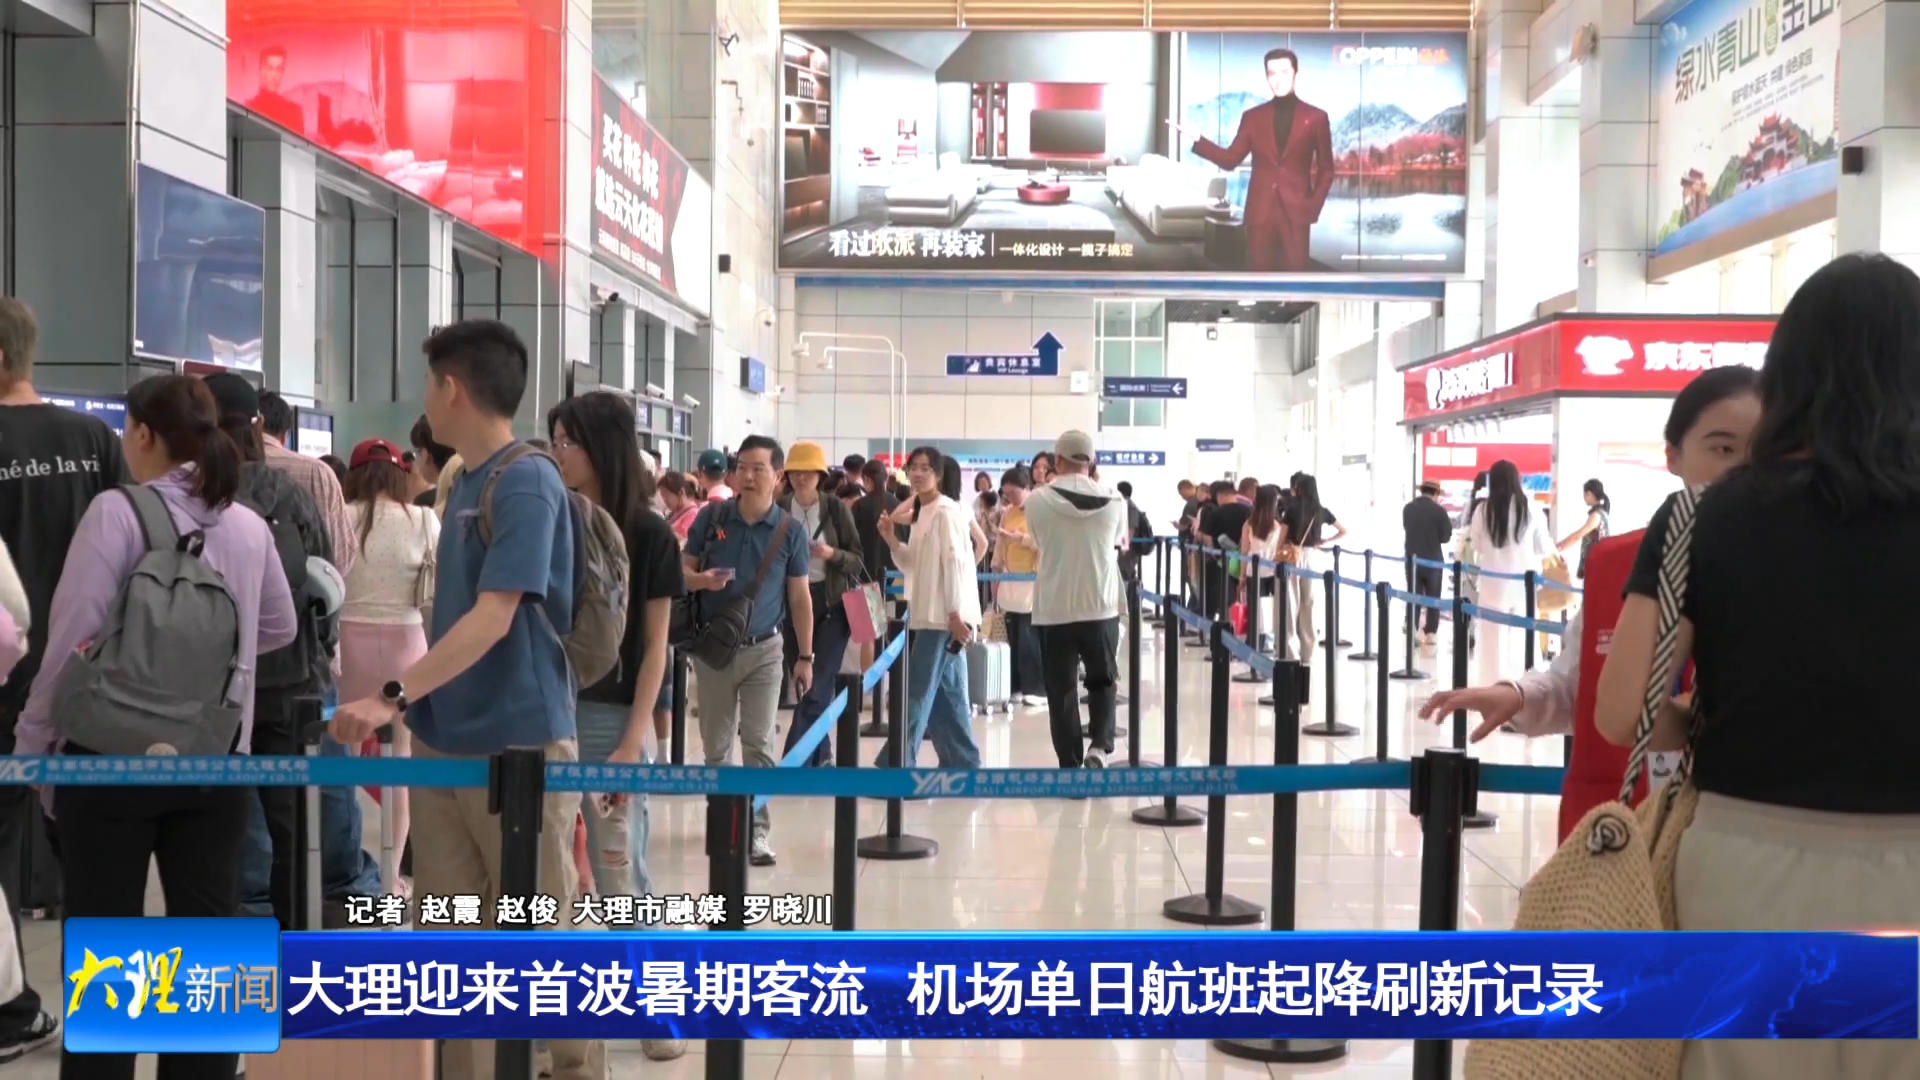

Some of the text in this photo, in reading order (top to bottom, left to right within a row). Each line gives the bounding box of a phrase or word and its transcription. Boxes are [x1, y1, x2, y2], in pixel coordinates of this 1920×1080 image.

[1340, 46, 1418, 66] OPPEIN
[1675, 7, 1761, 104] 绿水青山
[829, 229, 985, 258] 看过欧派 再装家
[999, 242, 1065, 257] 一体化设计
[26, 458, 51, 477] de
[54, 455, 79, 474] la
[81, 454, 100, 473] vi
